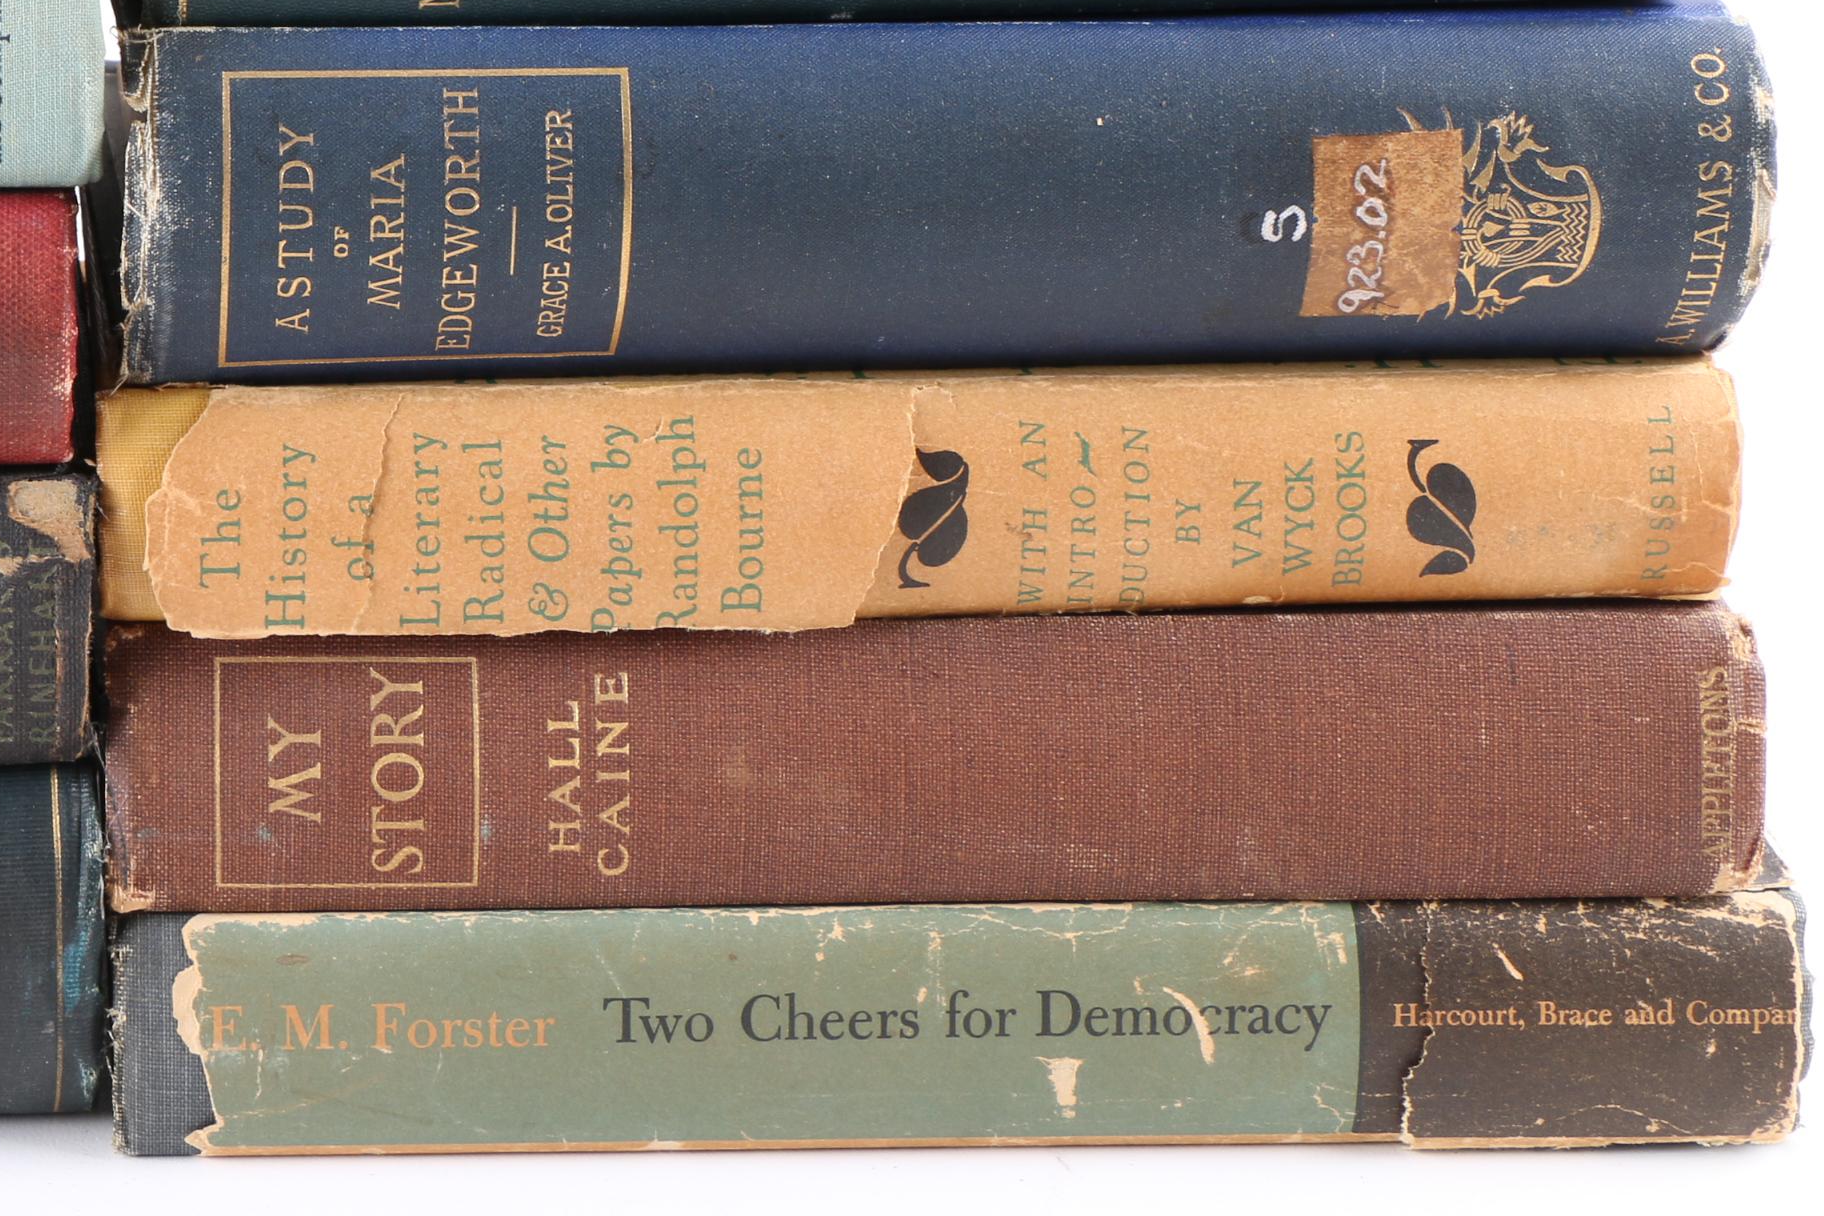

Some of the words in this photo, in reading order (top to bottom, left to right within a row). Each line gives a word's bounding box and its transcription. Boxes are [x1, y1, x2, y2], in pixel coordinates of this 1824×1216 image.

[1689, 47, 1731, 107] CO.
[1696, 114, 1734, 143] &
[276, 121, 316, 299] STUDY
[333, 225, 351, 259] OF
[367, 152, 407, 311] MARIA
[434, 86, 482, 353] EDGEWORTH
[1337, 158, 1389, 314] 923.02
[1664, 159, 1735, 329] WILLIAMS
[275, 308, 311, 335] A
[535, 261, 573, 340] GRACE
[346, 490, 376, 518] a
[526, 433, 571, 564] Other
[589, 423, 640, 474] by
[1017, 418, 1050, 483] AN
[1330, 428, 1369, 589] BROOKS
[1639, 404, 1676, 582] RUSSELL
[198, 486, 243, 590] The
[262, 440, 318, 631] History
[330, 534, 376, 584] of
[398, 430, 449, 630] Literary
[461, 437, 506, 626] Radical
[590, 492, 644, 634] Papers
[654, 415, 708, 628] Randolph
[720, 445, 765, 615] Bourne
[1017, 506, 1050, 607] WITH
[1119, 424, 1153, 607] DUCTION
[1176, 495, 1203, 547] BY
[1232, 477, 1264, 570] VAN
[1281, 455, 1317, 578] WYCK
[526, 580, 571, 624] &
[265, 712, 323, 824] MY
[368, 665, 426, 875] STORY
[546, 699, 582, 854] HALL
[594, 669, 632, 878] CAINE
[206, 1003, 264, 1052] E.
[280, 1002, 350, 1052] M.
[371, 1000, 557, 1052] Forster
[602, 995, 715, 1045] Two
[739, 992, 921, 1042] Cheers
[944, 989, 1018, 1039] for
[1035, 988, 1333, 1052] Democracy
[1392, 1000, 1526, 1031] Harcourt,
[1537, 1000, 1613, 1028] Brace
[1624, 997, 1676, 1026] and
